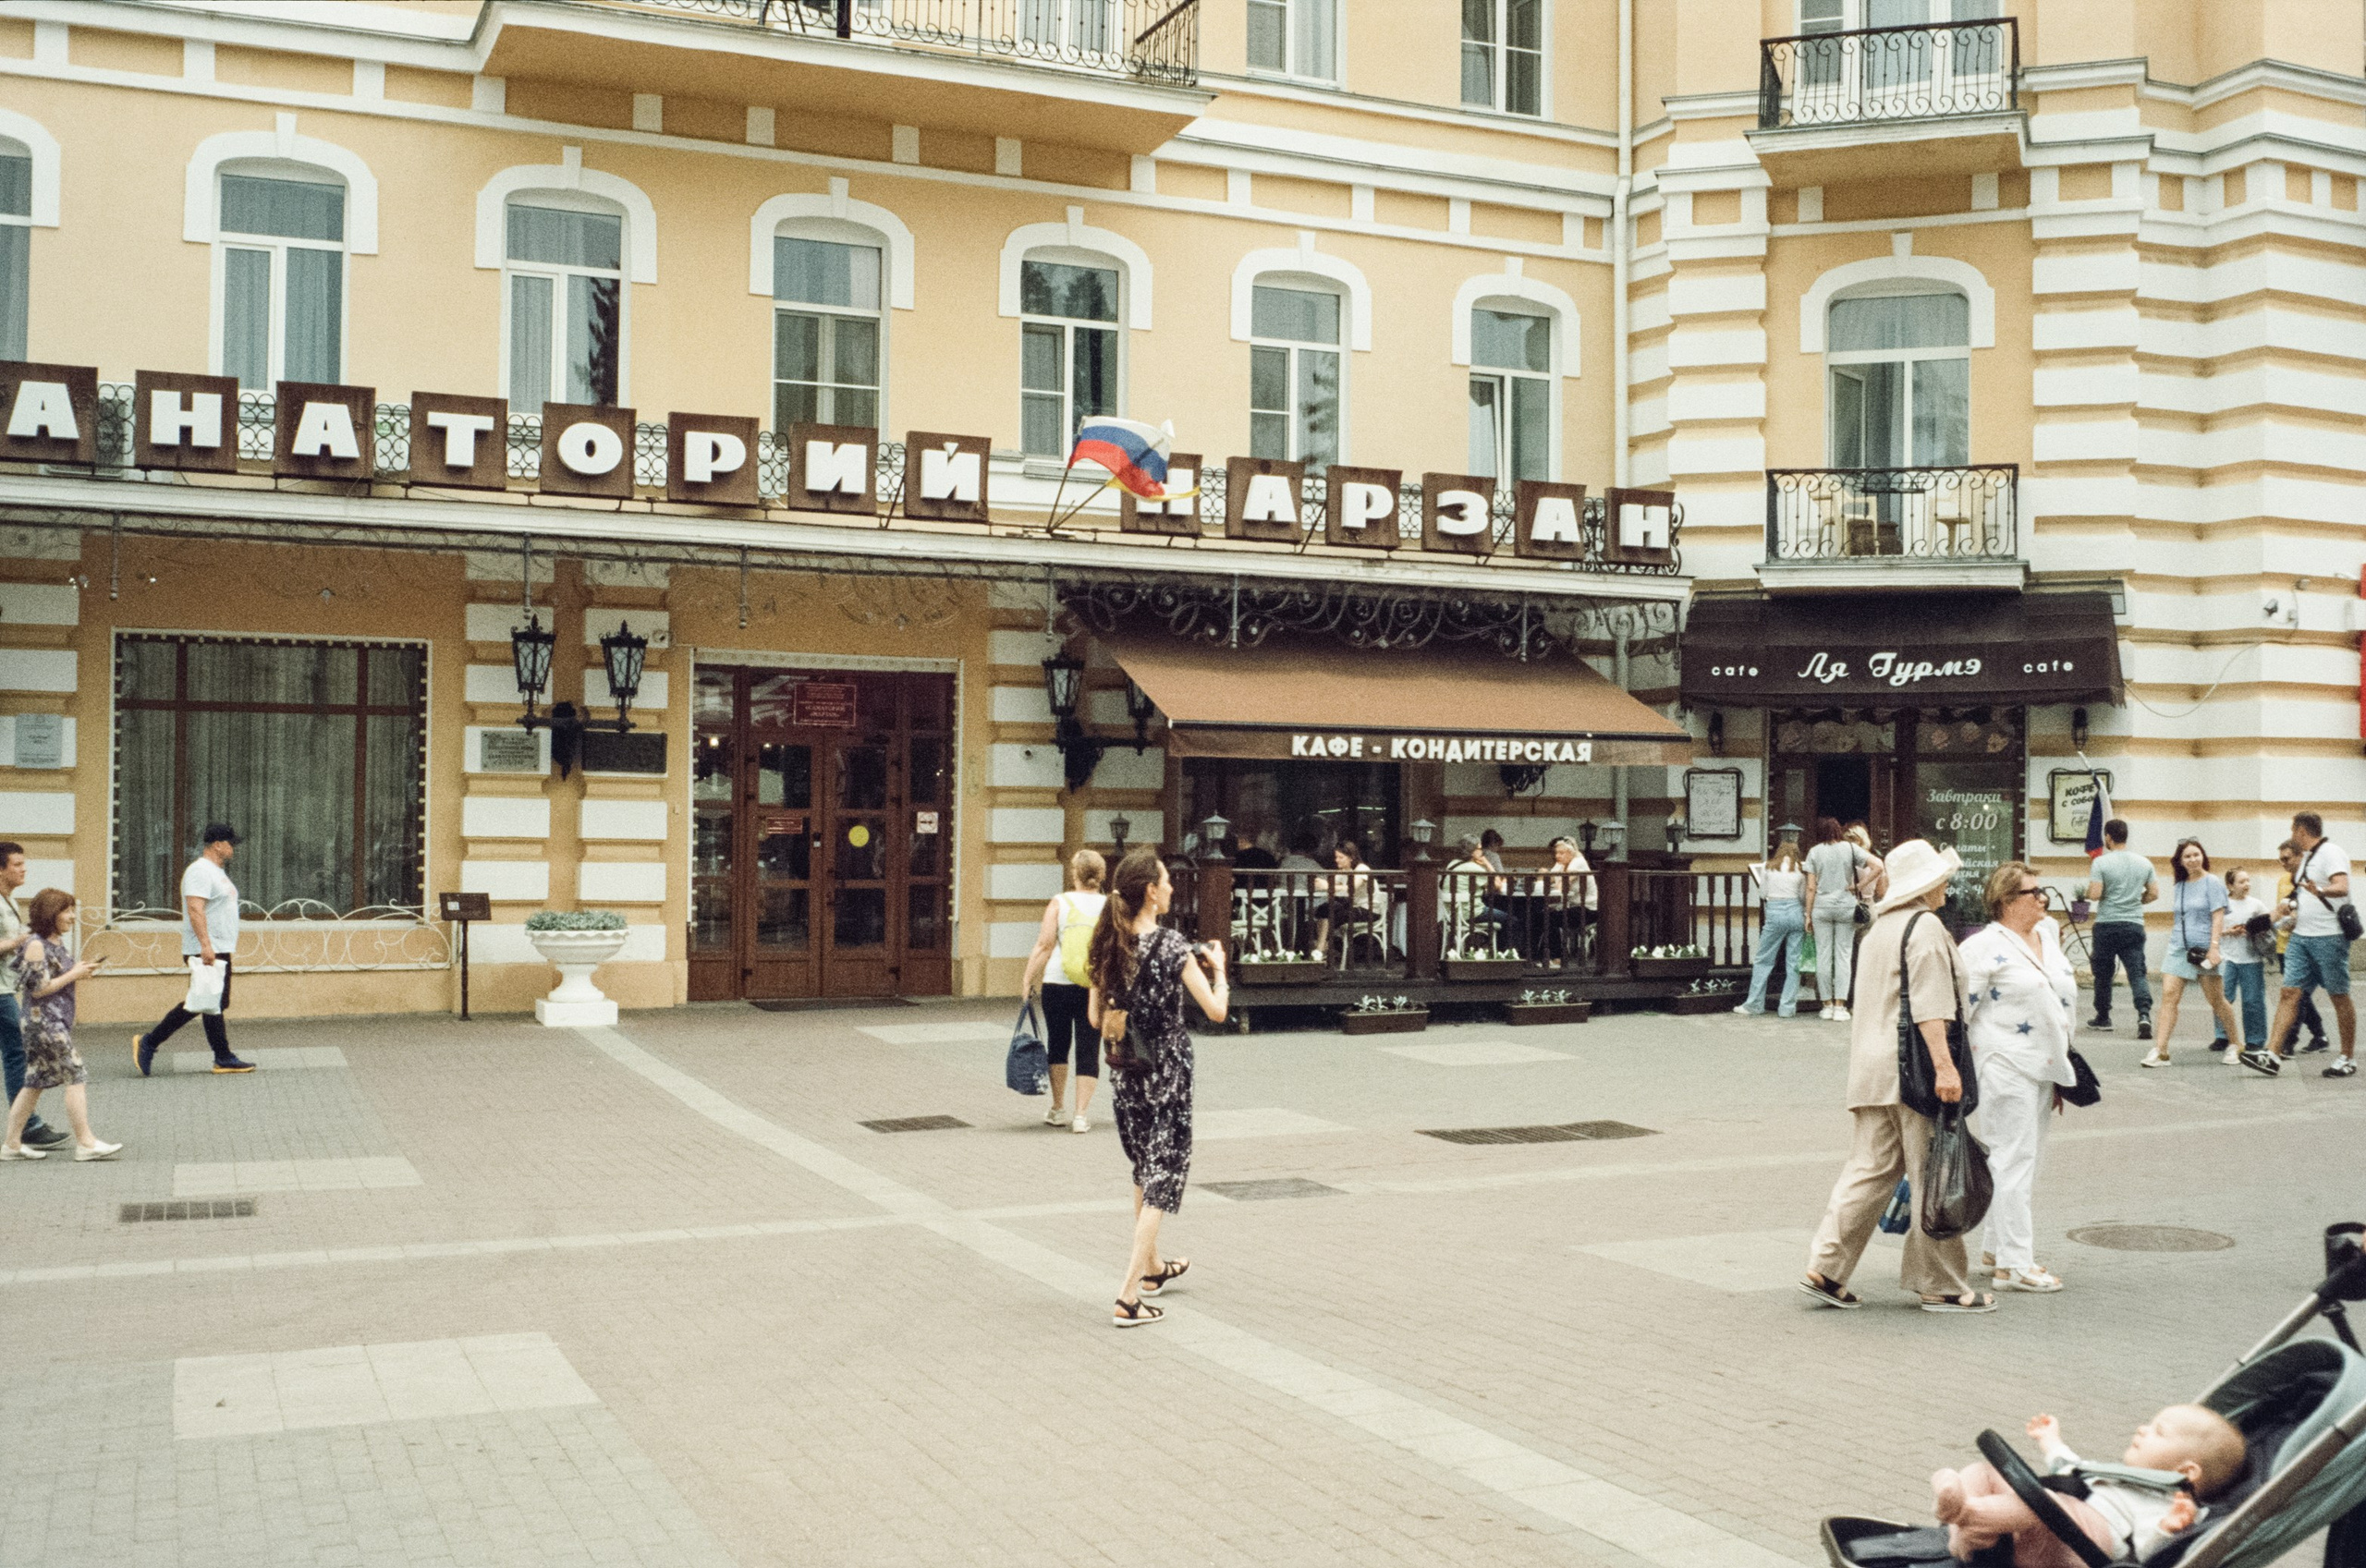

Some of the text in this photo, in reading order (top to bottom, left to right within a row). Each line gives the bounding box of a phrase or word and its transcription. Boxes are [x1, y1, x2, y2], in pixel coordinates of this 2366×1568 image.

[6, 380, 981, 503] АНАТОРИЙ
[1712, 665, 1759, 676] cafe
[1798, 652, 1982, 687] Ля Гурмэ
[2023, 660, 2073, 674] cafe
[1291, 735, 1363, 758] КАФЕ
[1390, 737, 1592, 763] КОНДИТЕРСКАЯ
[1926, 788, 2002, 806] Завтраки
[2065, 783, 2096, 796] КОФЕ
[1949, 812, 1998, 831] 8:00
[1939, 842, 1987, 853] Слаты
